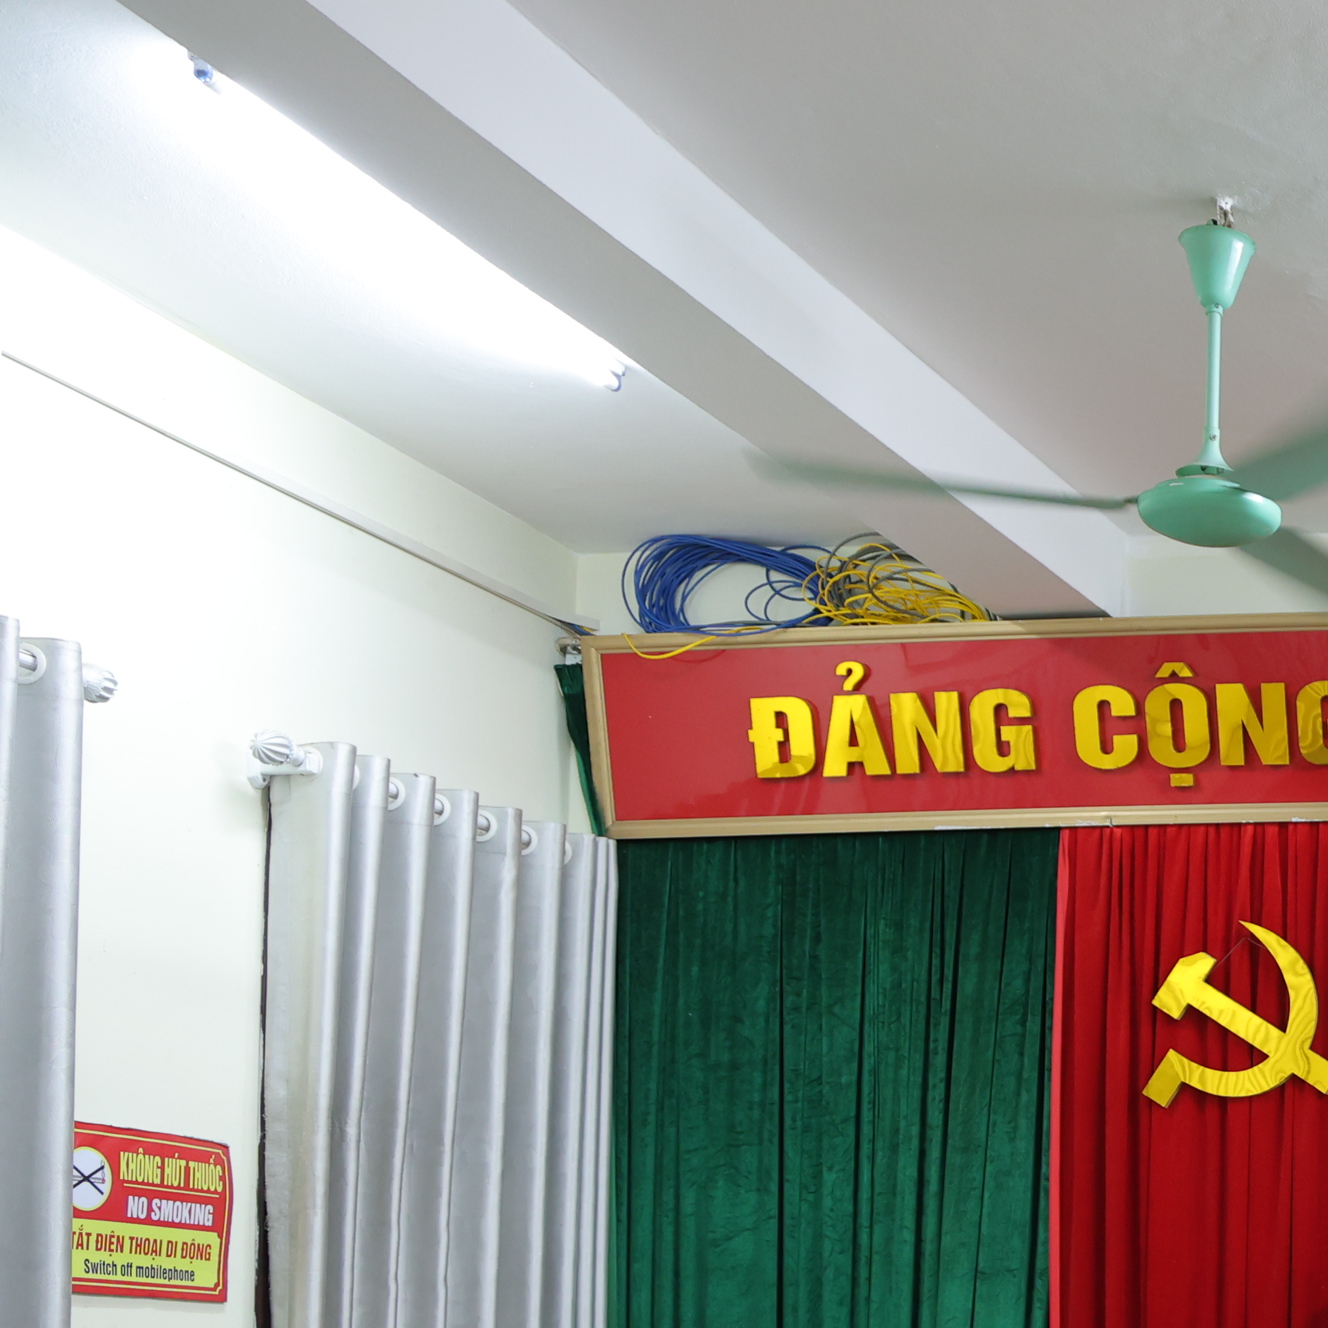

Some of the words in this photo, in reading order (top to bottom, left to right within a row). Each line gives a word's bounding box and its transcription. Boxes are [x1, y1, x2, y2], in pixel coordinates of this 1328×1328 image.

[747, 660, 1036, 779] ĐẢNG
[119, 1147, 161, 1185] KHÔNG
[164, 1152, 186, 1187] HÚT
[188, 1154, 223, 1192] THUỐC
[127, 1195, 148, 1219] NO
[151, 1199, 214, 1226] SMOKING
[95, 1230, 125, 1257] ĐIỆN
[128, 1236, 163, 1261] THOẠI
[165, 1240, 178, 1259] DI
[180, 1239, 212, 1264] ĐỘNG
[83, 1258, 118, 1277] Switch
[120, 1262, 133, 1277] off
[135, 1263, 196, 1283] mobilephone
